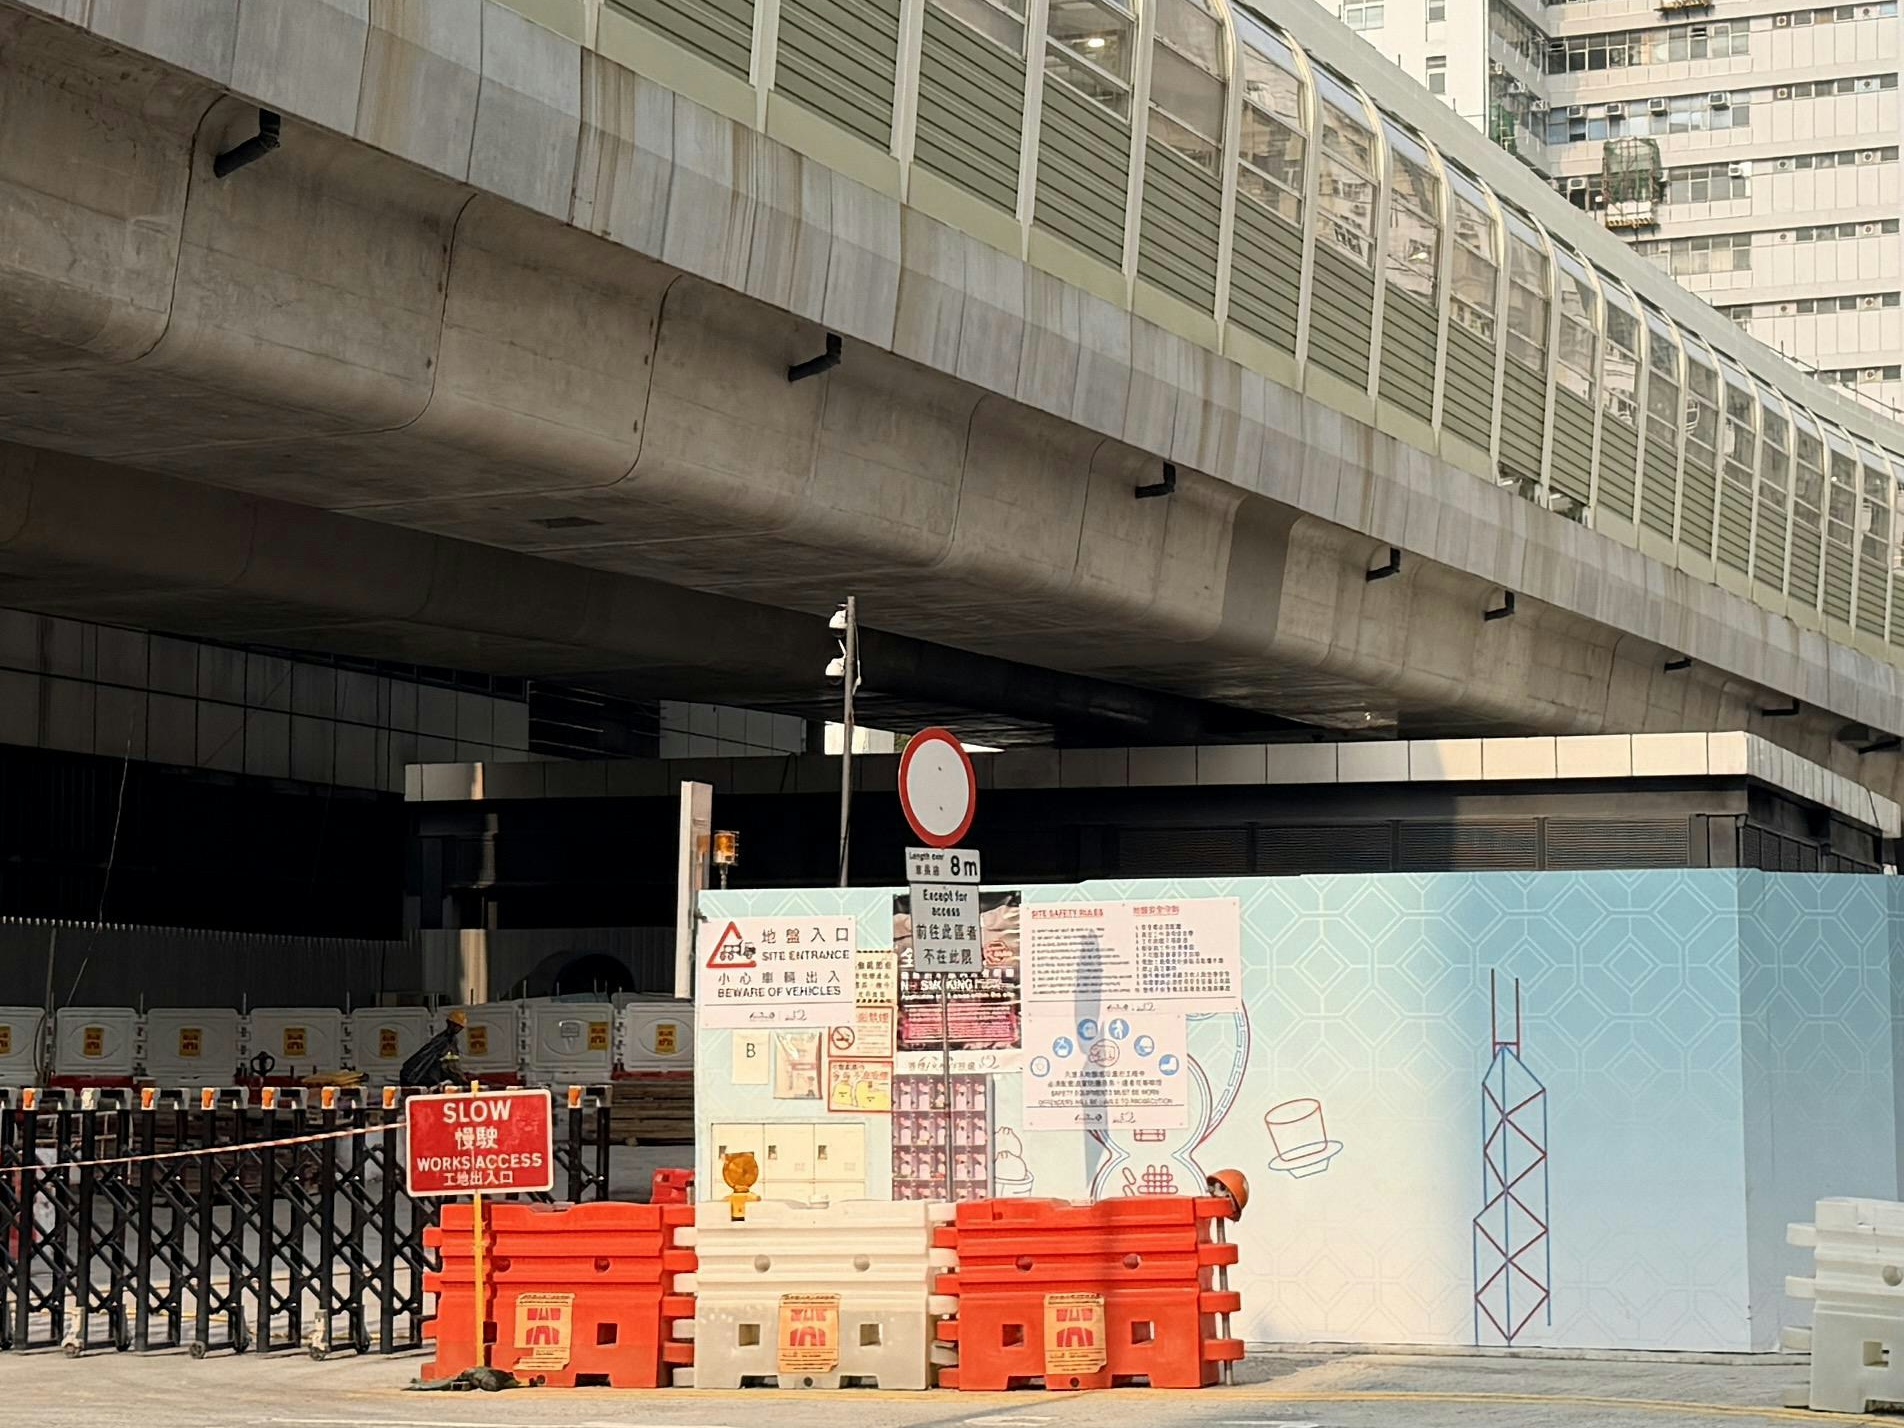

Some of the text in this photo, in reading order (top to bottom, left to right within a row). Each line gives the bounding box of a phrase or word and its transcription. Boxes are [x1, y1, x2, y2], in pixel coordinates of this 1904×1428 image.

[923, 889, 968, 902] Except for
[932, 907, 961, 917] access
[761, 927, 849, 944] 地盤入口
[761, 949, 850, 962] SITE ENTRANCE
[717, 985, 842, 998] BEWARE OF VEHICLES
[746, 1042, 756, 1058] B
[443, 1099, 512, 1124] SLOW
[455, 1126, 499, 1151] 慢駛
[417, 1152, 543, 1172] WORKS ACCESS
[443, 1170, 514, 1186] 工地出入口
